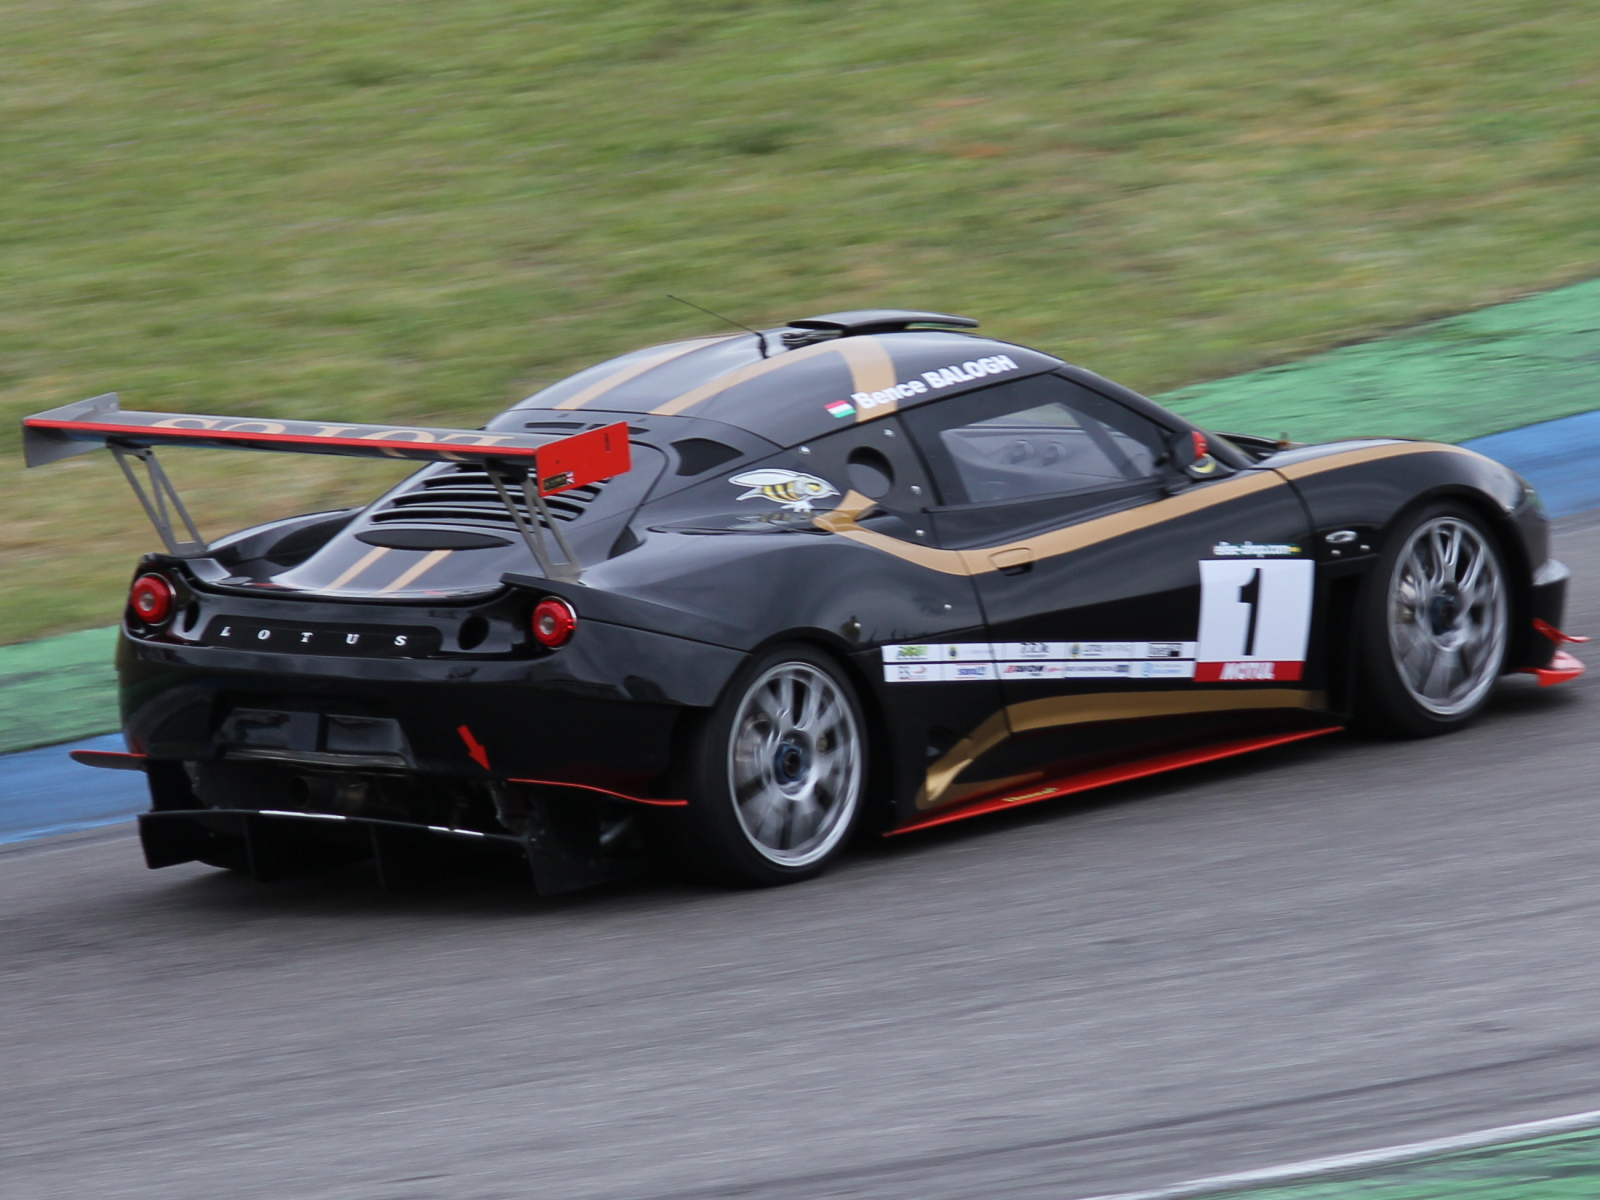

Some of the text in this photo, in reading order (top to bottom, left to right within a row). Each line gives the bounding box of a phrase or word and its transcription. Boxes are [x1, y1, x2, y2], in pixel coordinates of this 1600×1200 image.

[851, 354, 1020, 409] Bence BALOGH
[1238, 567, 1263, 657] 1
[219, 626, 408, 646] LOTUS
[1218, 661, 1275, 680] MOTUL
